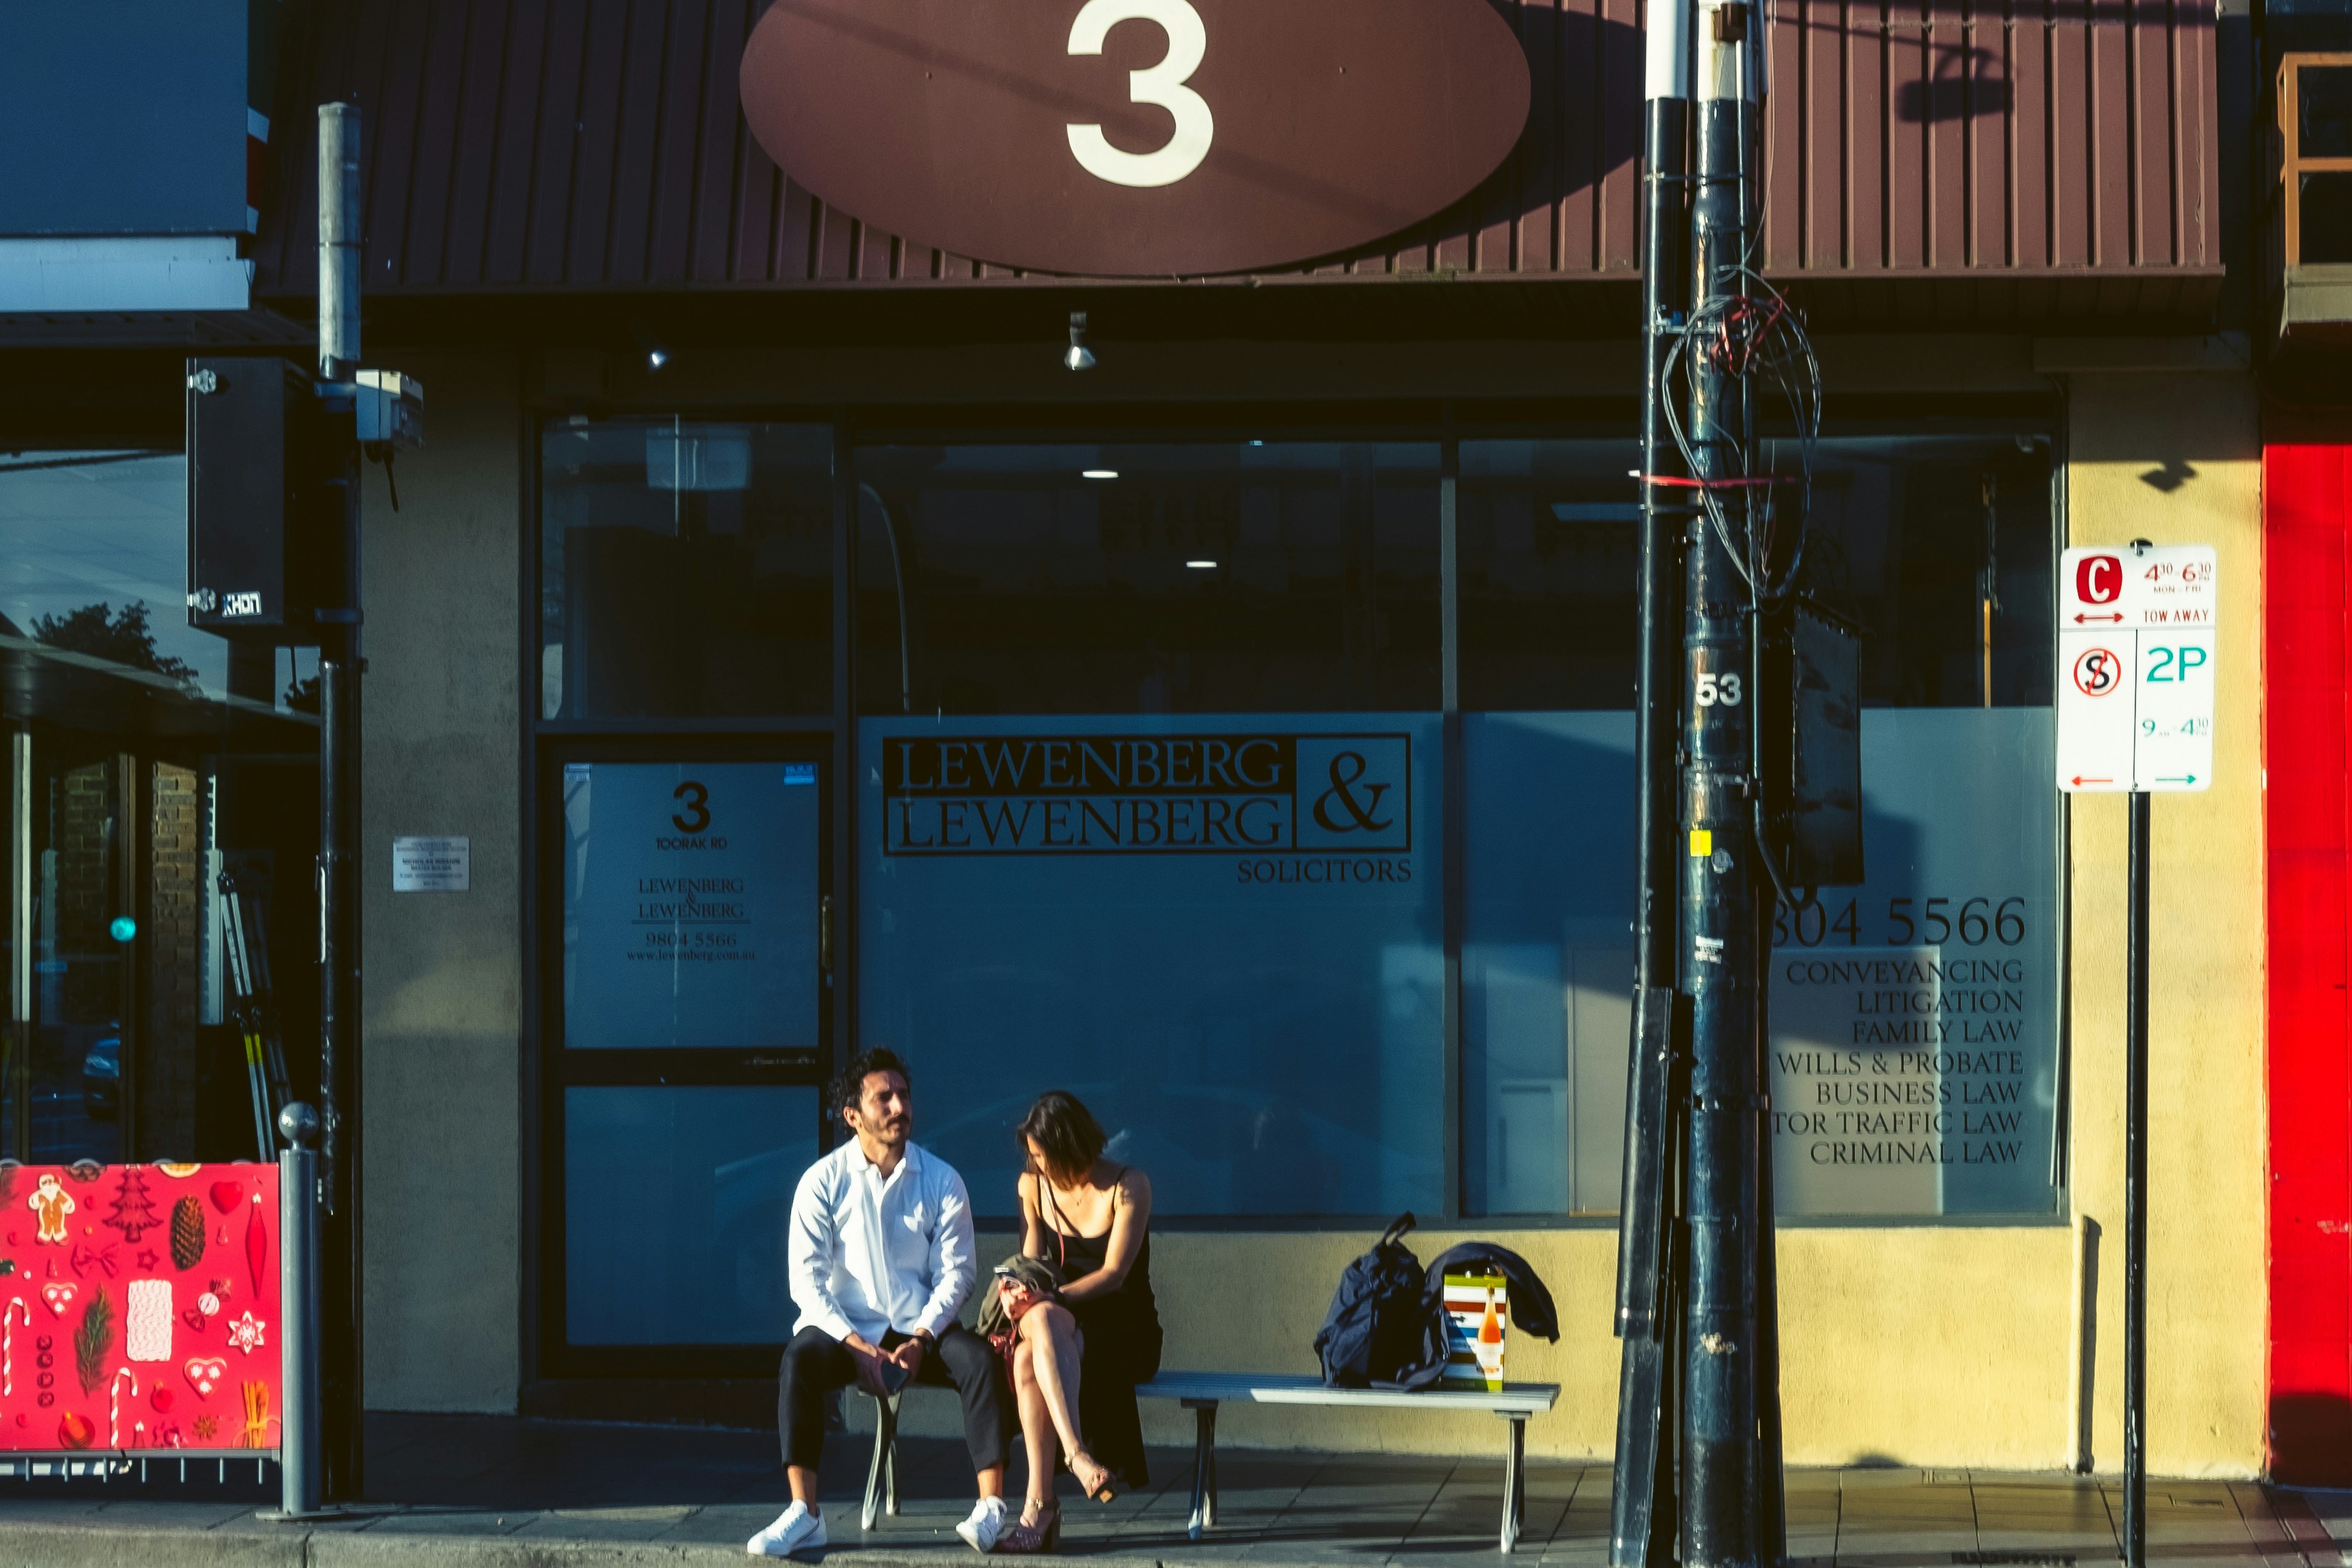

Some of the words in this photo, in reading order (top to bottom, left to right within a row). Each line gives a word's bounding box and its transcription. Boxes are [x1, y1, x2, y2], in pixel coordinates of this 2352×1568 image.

[1067, 0, 1214, 187] 3
[2143, 608, 2168, 623] TOW
[2173, 608, 2209, 623] AWAY
[2146, 647, 2207, 682] 2P
[1695, 673, 1742, 707] 53
[897, 739, 1282, 788] LEWENBERG
[1312, 751, 1394, 833] &
[671, 780, 711, 834] 3
[897, 796, 1283, 848] LEWENBERG
[656, 836, 707, 850] TOORAK
[710, 836, 728, 850] RD
[1237, 858, 1412, 884] SOLICITORS
[638, 877, 744, 894] LEWENBERG
[638, 902, 744, 919] LEWENBERG
[1772, 897, 1861, 948] 04
[1887, 896, 2026, 947] 5566
[646, 932, 689, 948] 9804
[694, 932, 737, 948] 5566
[627, 948, 755, 963] www.lewenberg.com.au
[1786, 958, 2023, 986] CONVEYANCING
[1856, 989, 2023, 1014] LITIGATION
[1853, 1019, 1953, 1044] FAMILY
[1963, 1019, 2023, 1044] LAW
[1775, 1050, 1861, 1075] WILLS
[1871, 1050, 1888, 1075] &
[1899, 1050, 2024, 1075] PROBATE
[1816, 1080, 1952, 1105] BUSINESS
[1962, 1080, 2023, 1104] LAW
[1772, 1111, 1828, 1135] TOR
[1836, 1111, 1952, 1135] TRAFFIC
[1963, 1111, 2023, 1135] LAW
[1810, 1140, 1954, 1165] CRIMINAL
[1963, 1140, 2023, 1165] LAW
